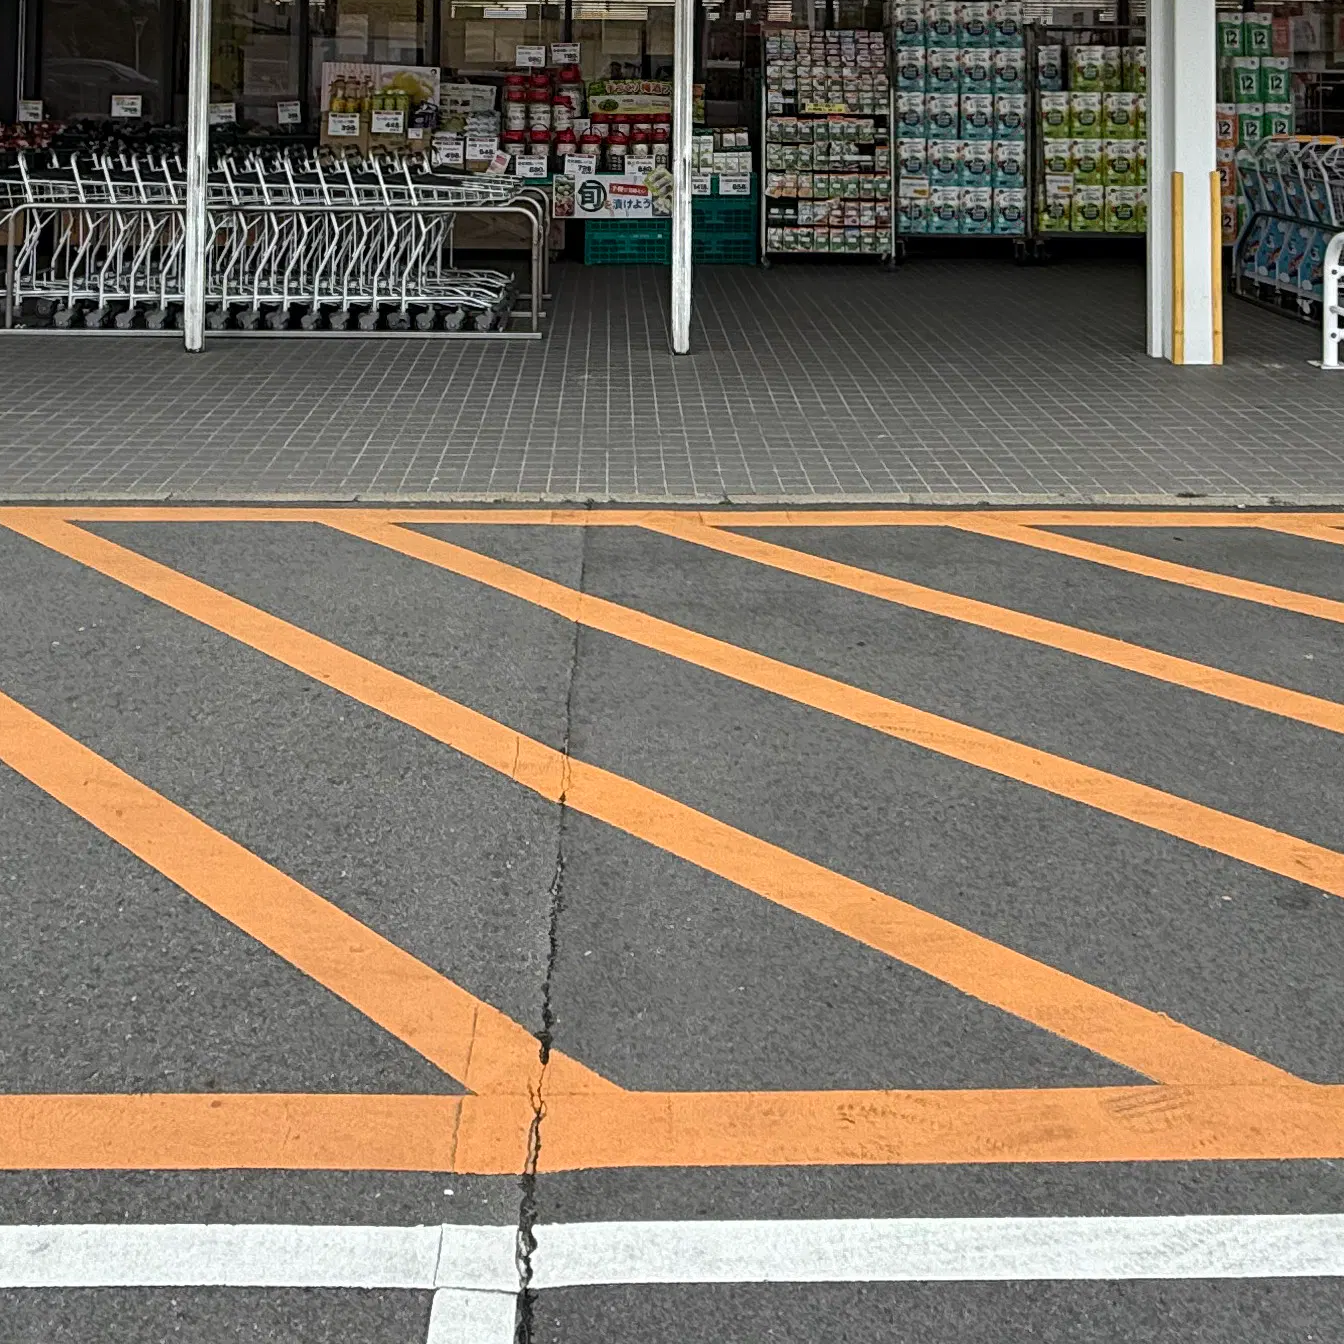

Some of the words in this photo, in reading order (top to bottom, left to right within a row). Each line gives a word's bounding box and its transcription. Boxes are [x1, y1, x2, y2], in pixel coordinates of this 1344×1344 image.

[1226, 31, 1238, 44] 12
[1254, 32, 1265, 45] 12
[1242, 76, 1254, 89] 12
[1270, 76, 1282, 89] 12
[1219, 121, 1231, 134] 12
[1246, 123, 1258, 136] 12
[1274, 121, 1286, 134] 12
